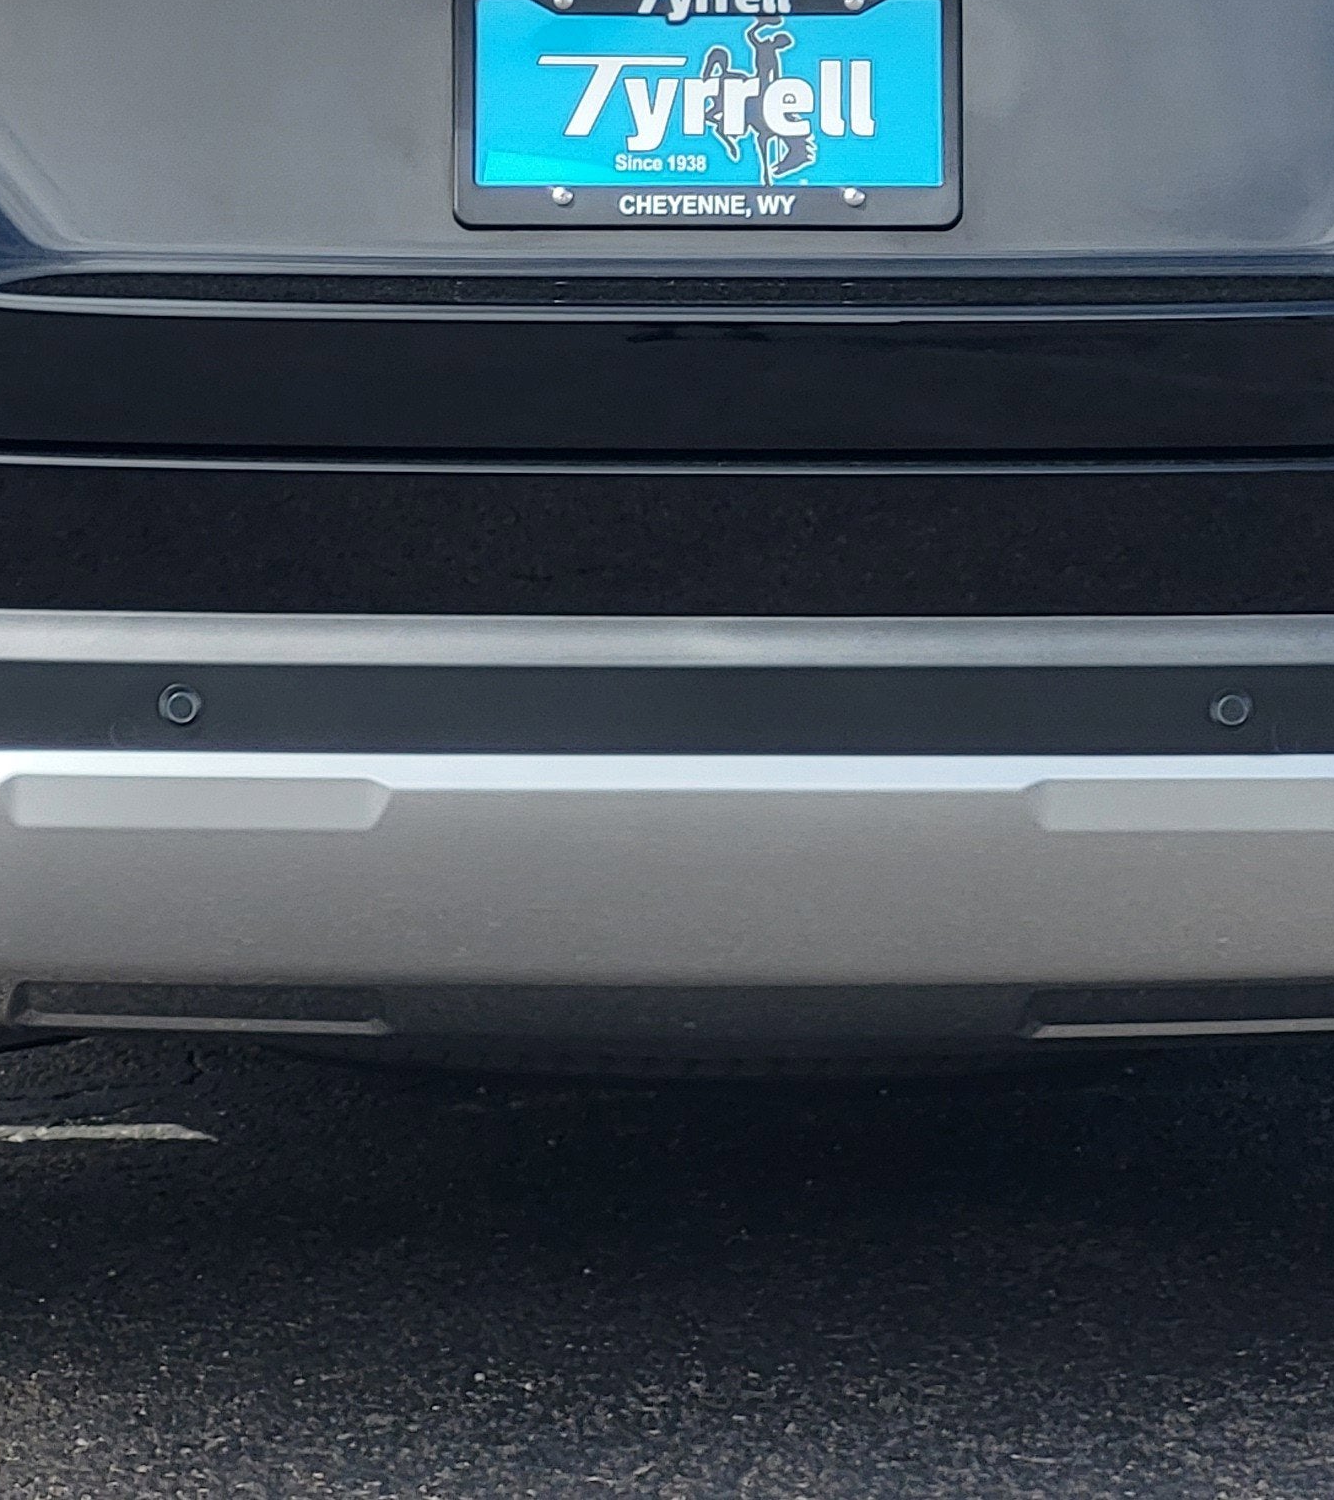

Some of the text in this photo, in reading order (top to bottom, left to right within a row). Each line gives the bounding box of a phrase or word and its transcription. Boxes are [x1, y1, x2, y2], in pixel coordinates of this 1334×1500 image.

[538, 56, 875, 151] Tyrrell
[614, 153, 707, 172] Since 1938
[618, 194, 796, 217] CHEYENNE, WY
